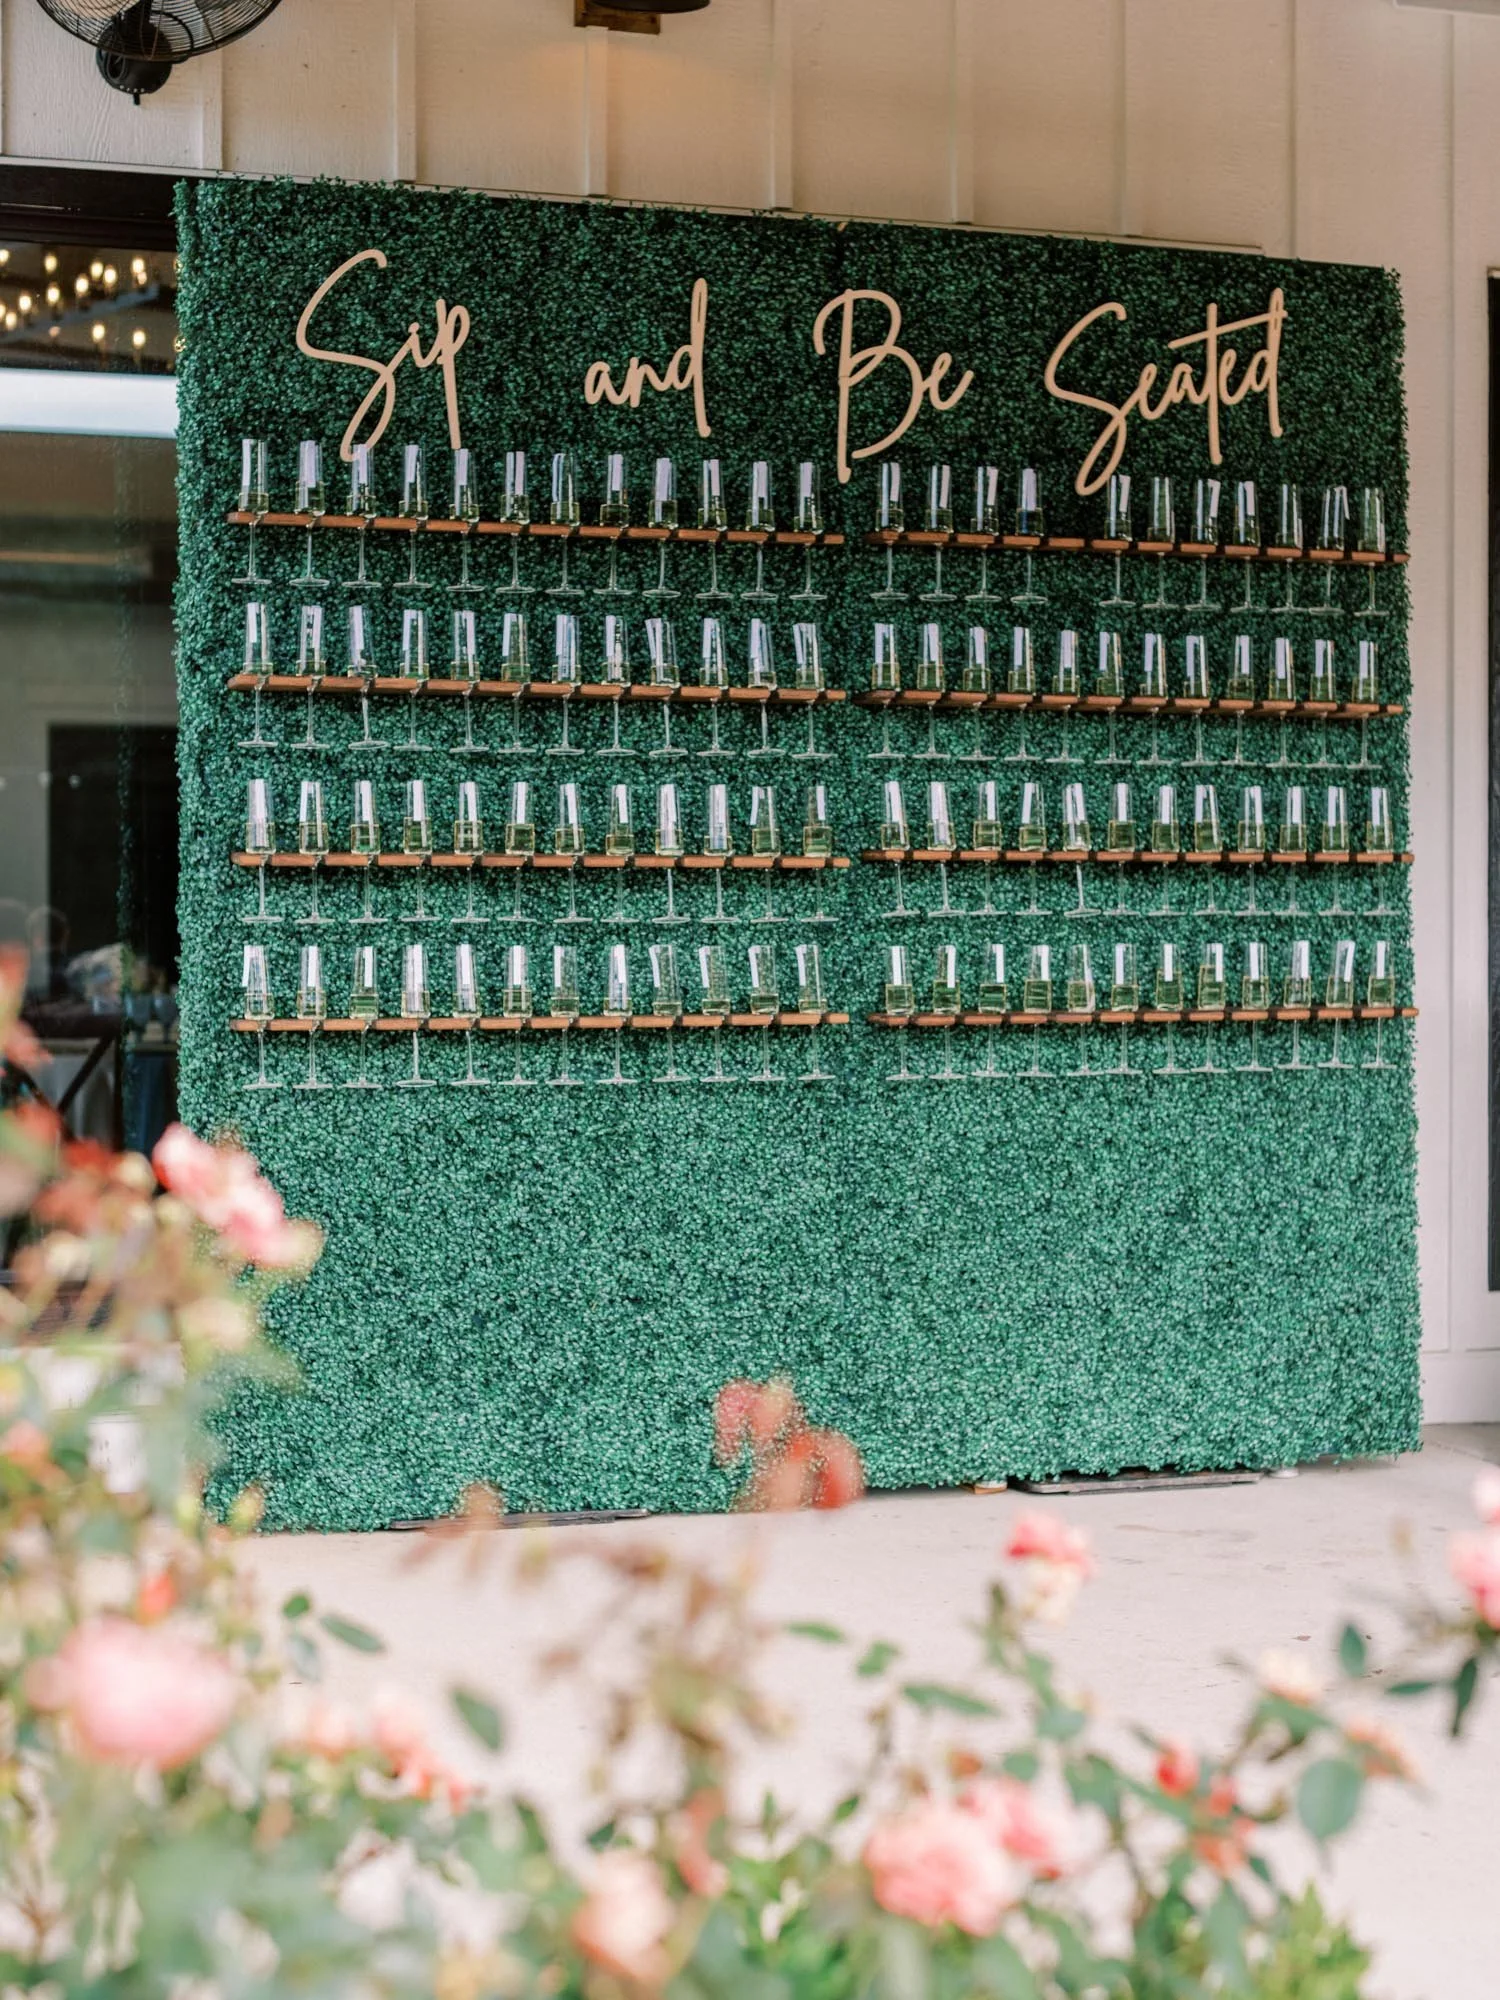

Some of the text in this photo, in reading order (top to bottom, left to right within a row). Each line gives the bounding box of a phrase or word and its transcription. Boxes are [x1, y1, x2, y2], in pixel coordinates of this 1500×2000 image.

[296, 249, 1288, 496] Sip and Be Seated
